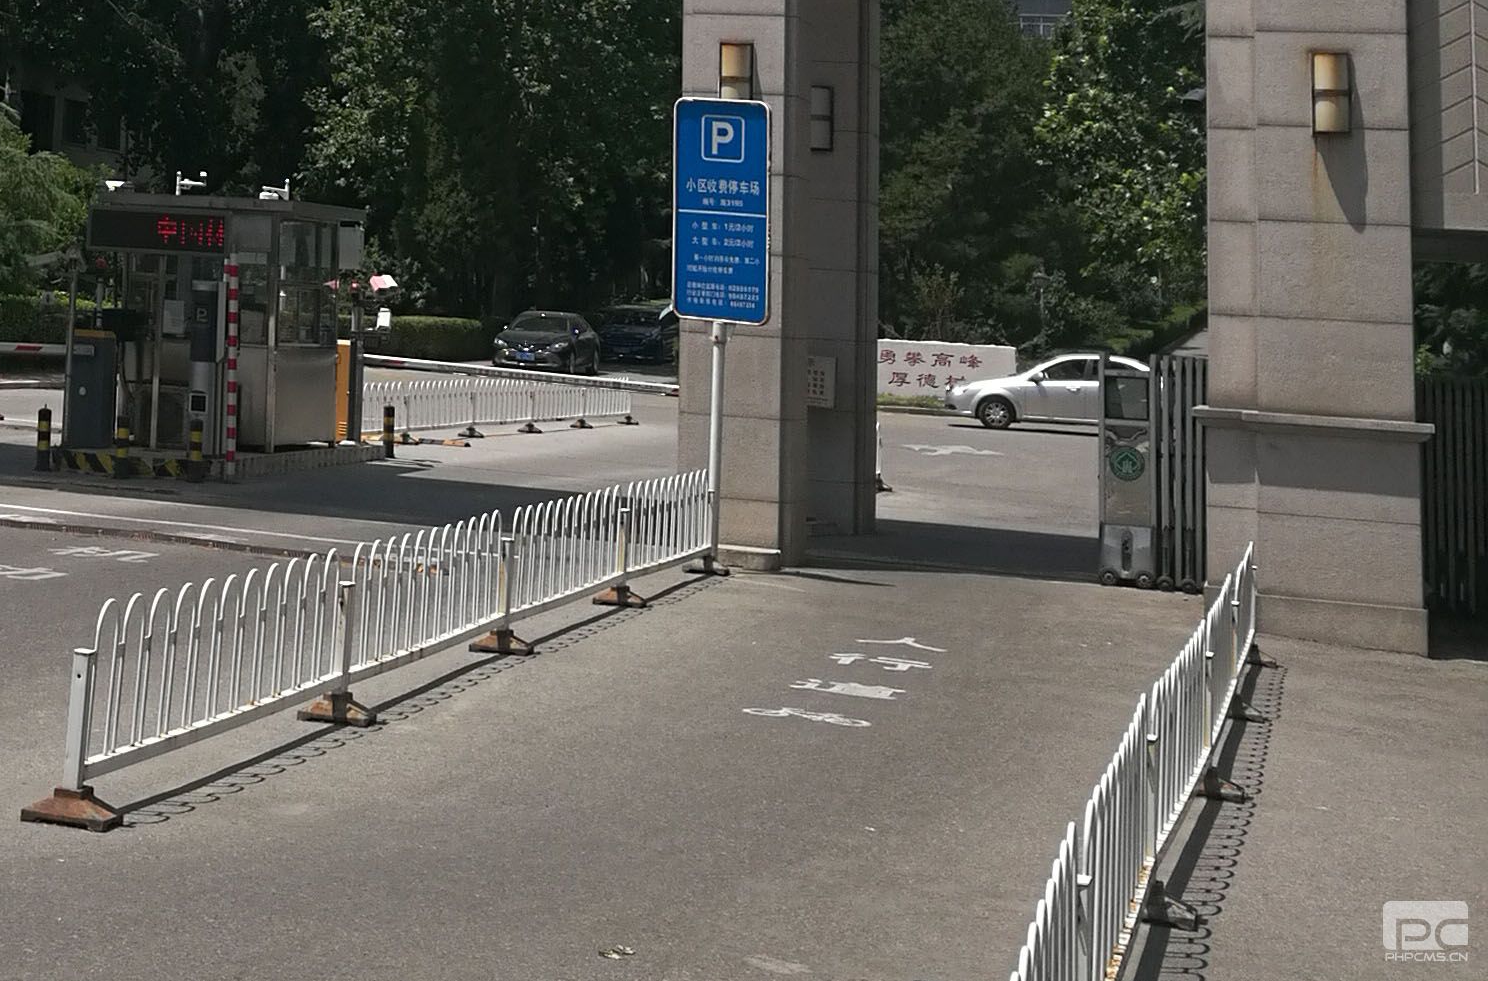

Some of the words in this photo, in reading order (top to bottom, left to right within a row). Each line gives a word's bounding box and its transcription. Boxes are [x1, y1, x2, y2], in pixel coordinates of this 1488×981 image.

[711, 121, 734, 155] P
[686, 177, 760, 196] 小区收费停车场
